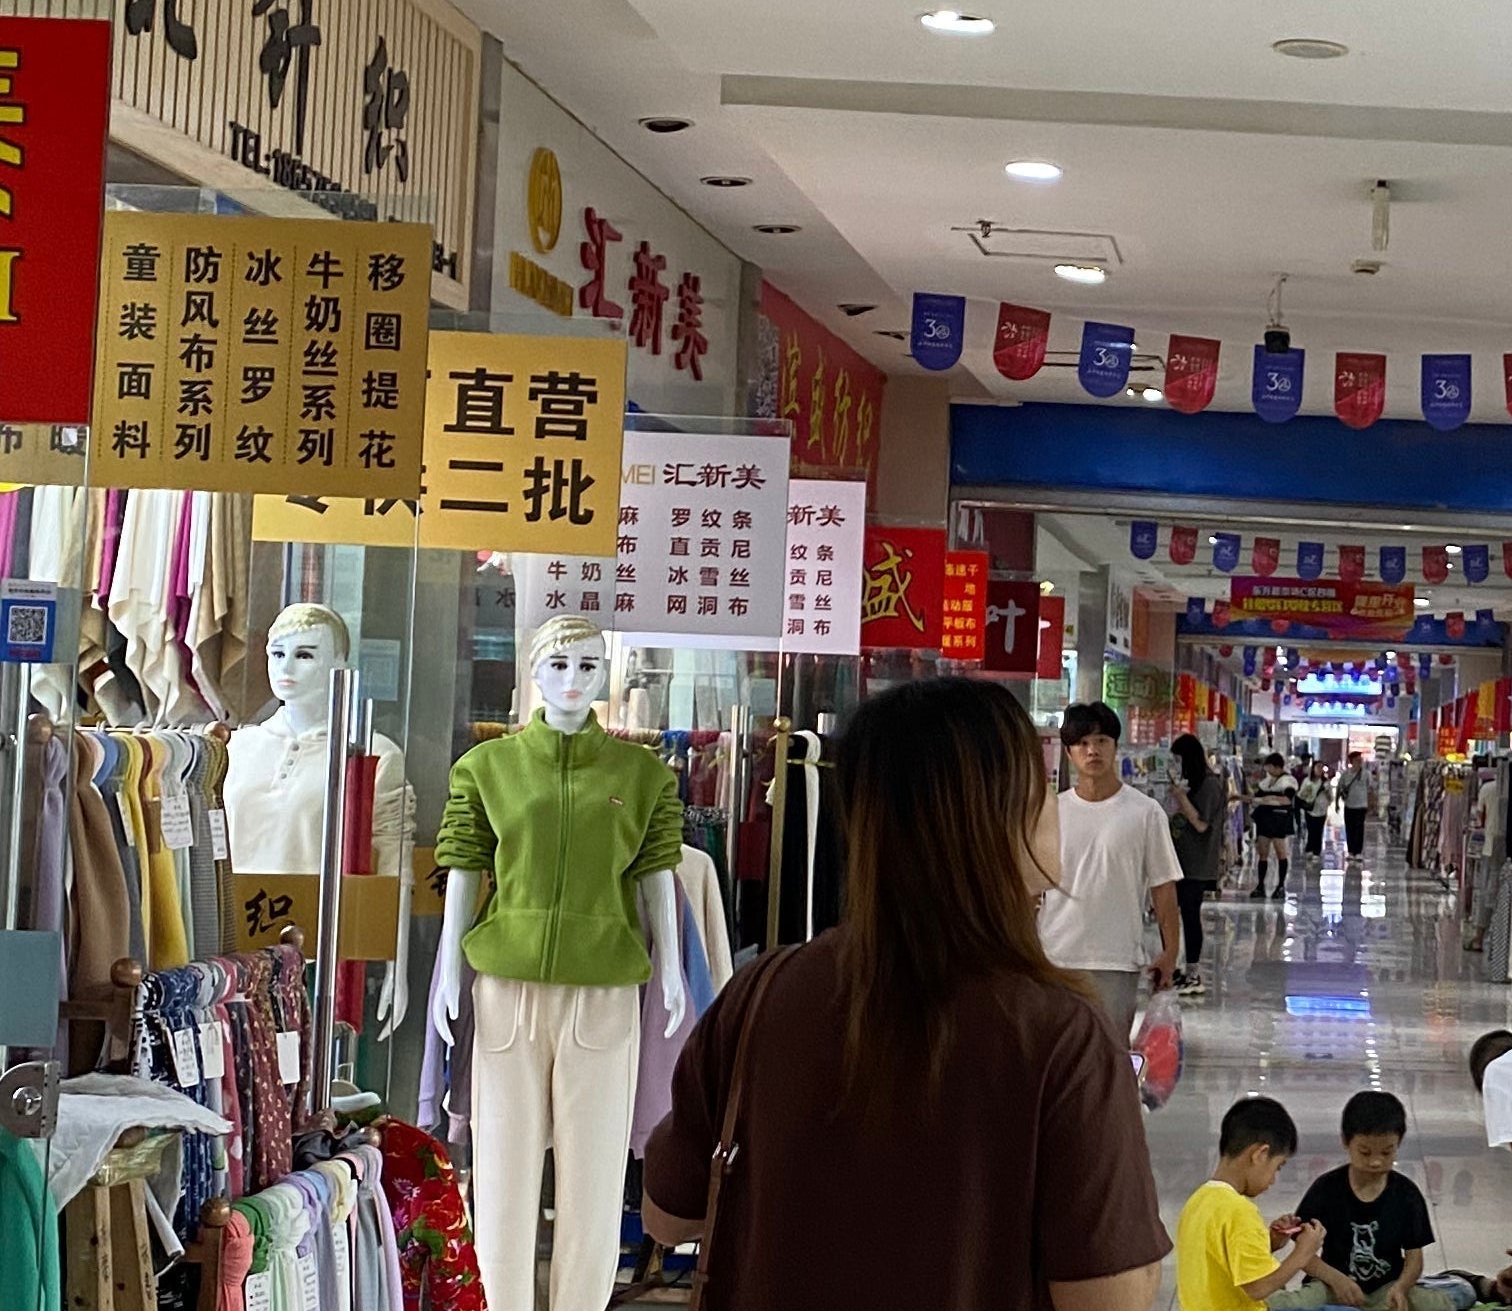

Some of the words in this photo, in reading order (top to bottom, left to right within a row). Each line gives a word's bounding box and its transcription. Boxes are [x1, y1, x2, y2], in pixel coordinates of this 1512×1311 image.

[112, 242, 161, 459] 童装面料
[174, 245, 222, 461] 防风布系列
[235, 249, 282, 463] 冰丝罗纹
[297, 251, 344, 466] 牛奶丝系列
[358, 252, 405, 469] 移圈提花
[443, 367, 599, 442] 直营
[663, 462, 767, 490] 汇新美
[619, 506, 639, 525] 麻
[671, 507, 752, 529] 罗纹条
[788, 504, 845, 528] 新美
[618, 535, 638, 555] 布
[669, 537, 751, 559] 直贡尼
[790, 544, 834, 562] 纹条
[548, 561, 637, 583] 牛奶丝
[668, 565, 750, 588] 冰雪丝
[789, 569, 832, 587] 贡尼
[546, 590, 635, 613] 水晶麻
[667, 595, 749, 617] 网洞布
[788, 594, 832, 611] 雪丝
[787, 618, 831, 636] 洞布
